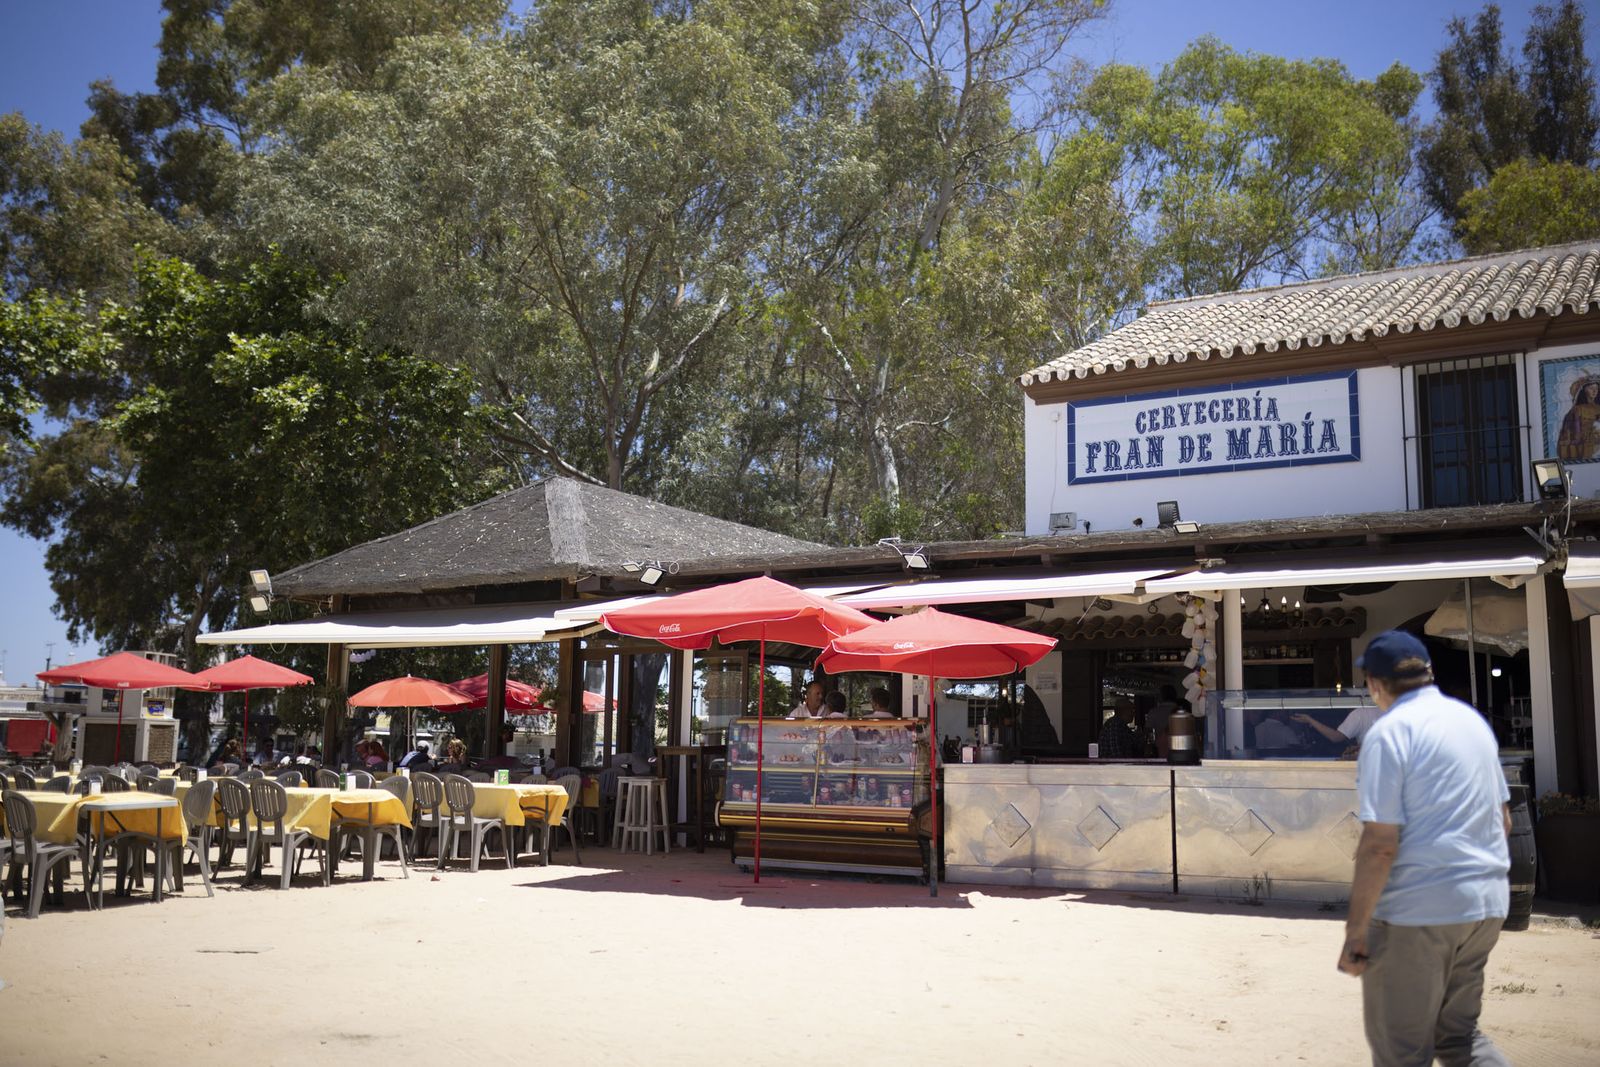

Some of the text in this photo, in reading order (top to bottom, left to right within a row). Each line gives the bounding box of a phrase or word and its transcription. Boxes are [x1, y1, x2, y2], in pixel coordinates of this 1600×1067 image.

[1135, 390, 1280, 434] CERVECERÍA
[1085, 411, 1340, 473] FRAN DE MARÍA
